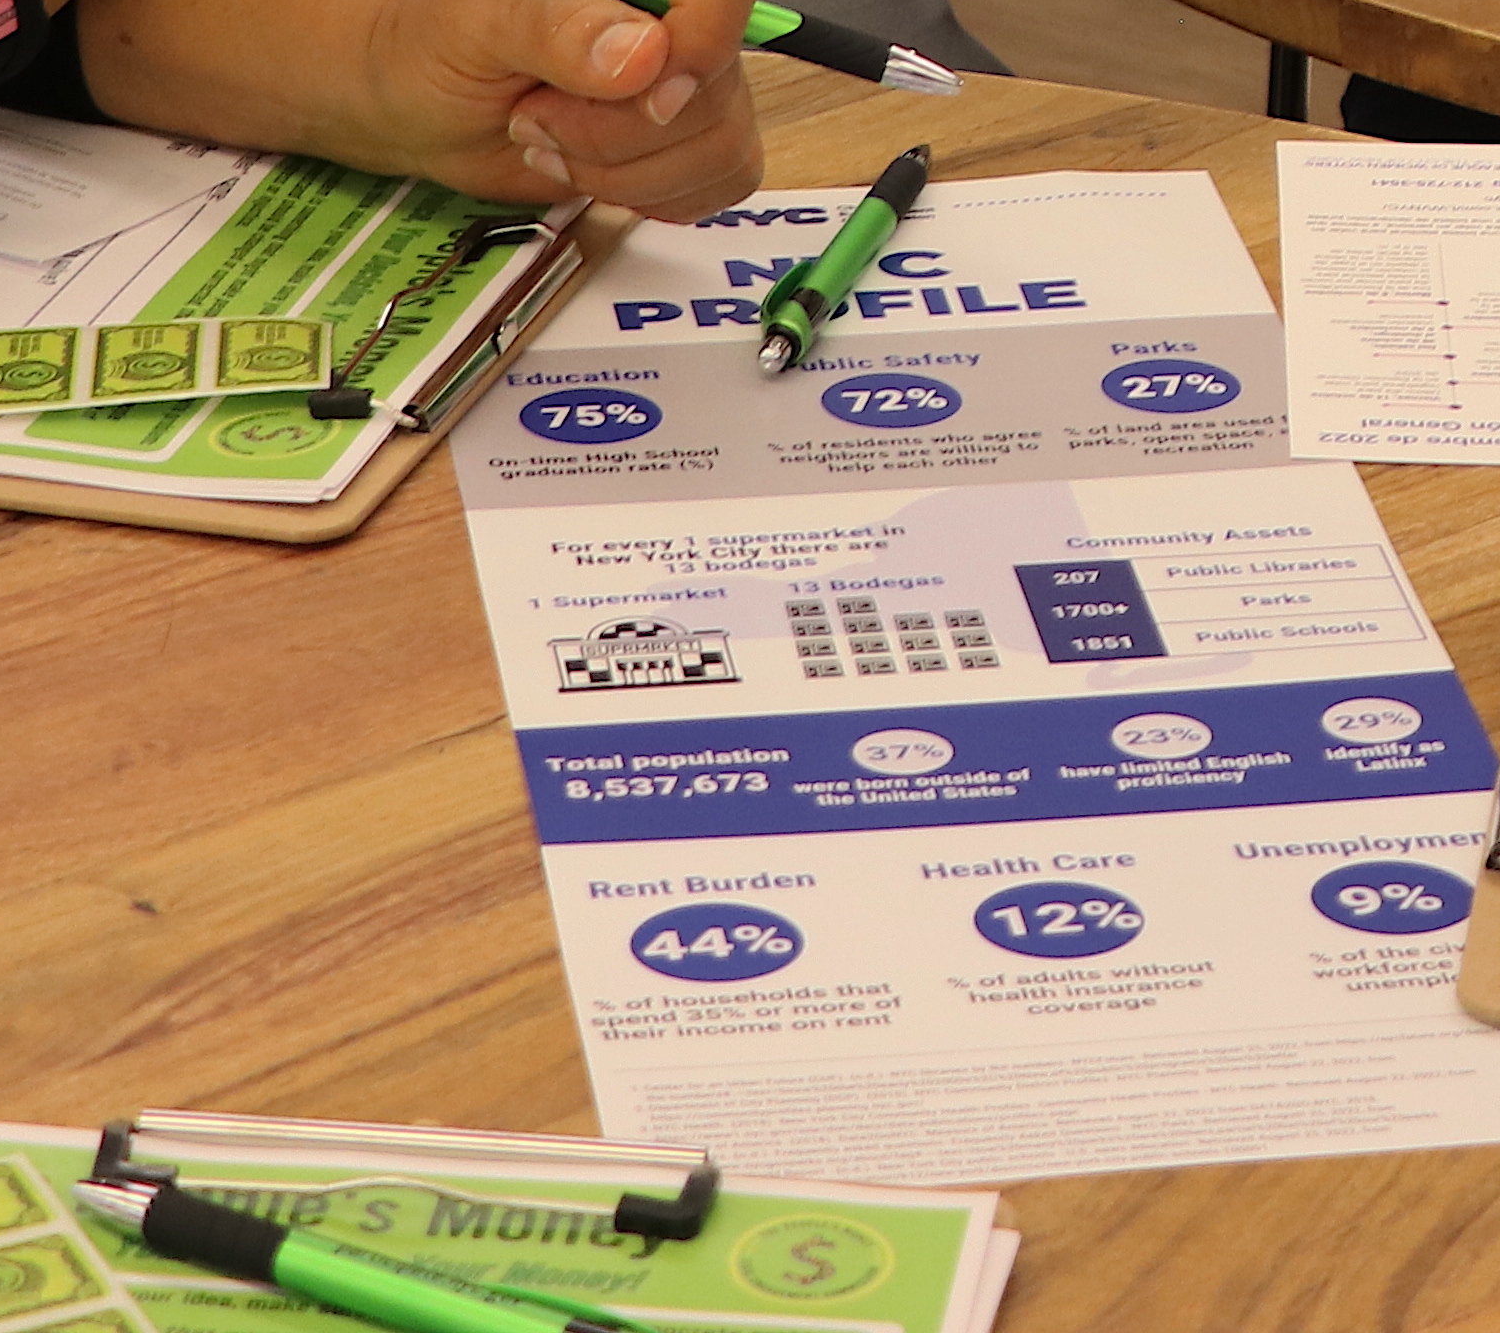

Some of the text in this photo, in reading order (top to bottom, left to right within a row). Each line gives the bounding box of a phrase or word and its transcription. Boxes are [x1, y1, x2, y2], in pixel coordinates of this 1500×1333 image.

[724, 251, 952, 286] NC
[613, 279, 1089, 332] PRFILE
[1111, 341, 1198, 355] Parks
[795, 351, 982, 373] ublic Safety
[505, 367, 660, 387] Education
[1121, 372, 1228, 399] 27%
[840, 388, 949, 413] 72%
[540, 404, 648, 430] 75%
[1361, 417, 1462, 431] General
[1319, 432, 1379, 444] 2022
[1386, 433, 1418, 444] de
[489, 446, 721, 469] On-time High School
[499, 458, 715, 481] graduation rate (%)
[550, 540, 595, 555] For
[602, 538, 675, 555] every
[707, 526, 876, 547] supermarket
[883, 524, 906, 536] in
[1066, 523, 1313, 549] Community Assets
[575, 538, 890, 567] New York City there are
[665, 556, 818, 575] 13 bodegas
[1053, 569, 1100, 586] 207
[1166, 556, 1358, 579] Public Libraries
[528, 586, 729, 609] 1 Supermarket
[788, 575, 946, 595] 13 Bodegas
[1051, 601, 1130, 619] 1700+
[1240, 592, 1313, 607] Parks
[1195, 620, 1379, 644] Public Schools
[1336, 711, 1413, 731] 29%
[1125, 726, 1204, 747] 23%
[544, 747, 791, 773] Total population
[864, 742, 946, 762] 37%
[1325, 739, 1446, 761] Identify as
[1060, 750, 1292, 779] have limited English
[1355, 755, 1429, 772] Latinx
[564, 771, 771, 802] 8,537,673
[793, 767, 1032, 794] were born outside of
[1115, 768, 1247, 791] proficiency
[815, 782, 1019, 807] the United States
[921, 849, 1137, 881] Health Care
[589, 871, 817, 899] Rent Burden
[1337, 883, 1444, 916] 9%
[992, 897, 1144, 939] 12%
[643, 923, 794, 961] 44%
[946, 959, 1216, 988] % of adults without
[594, 981, 893, 1011] % of households that
[968, 975, 1204, 1005] health insurance
[590, 994, 902, 1028] spend 35% or more of
[1026, 994, 1158, 1015] coverage
[600, 1012, 893, 1041] their income on rent
[427, 1195, 663, 1260] Mone
